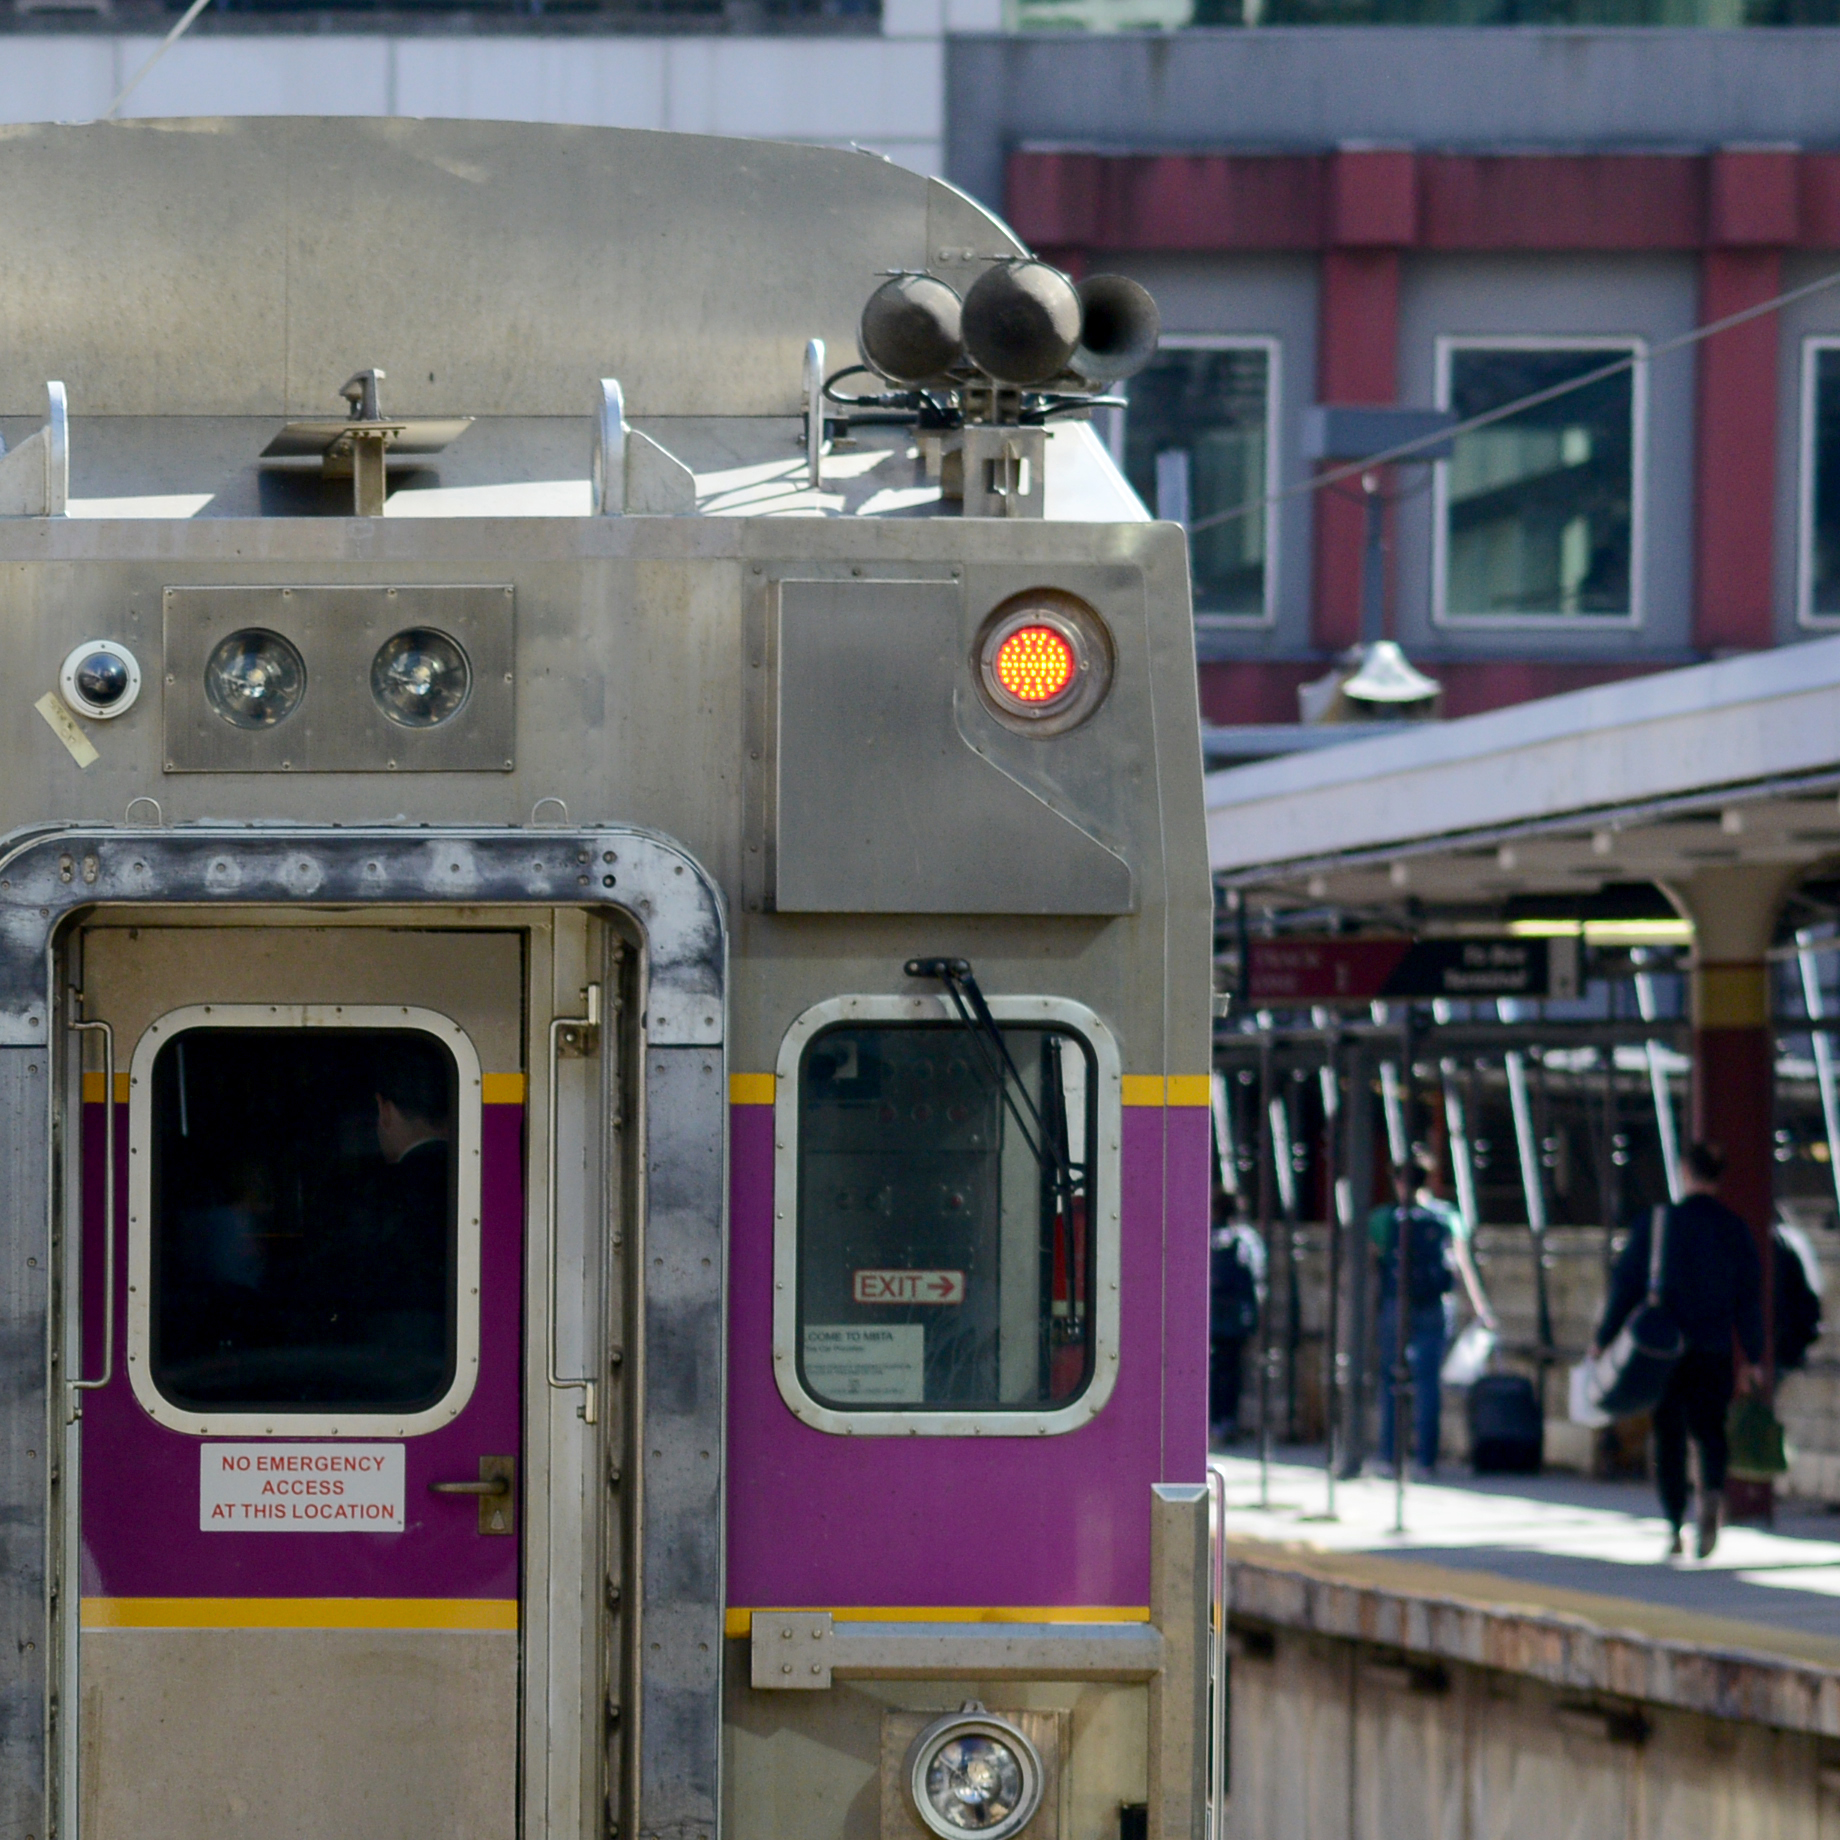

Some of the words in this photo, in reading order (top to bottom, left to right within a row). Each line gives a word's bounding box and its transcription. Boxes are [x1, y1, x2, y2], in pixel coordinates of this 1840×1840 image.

[861, 1275, 922, 1298] EXIT
[222, 1456, 251, 1471] NO
[257, 1456, 385, 1471] EMERGENCY
[261, 1480, 345, 1495] ACCESS
[211, 1503, 236, 1519] AT
[241, 1503, 287, 1519] THIS
[293, 1503, 395, 1519] LOCATION
